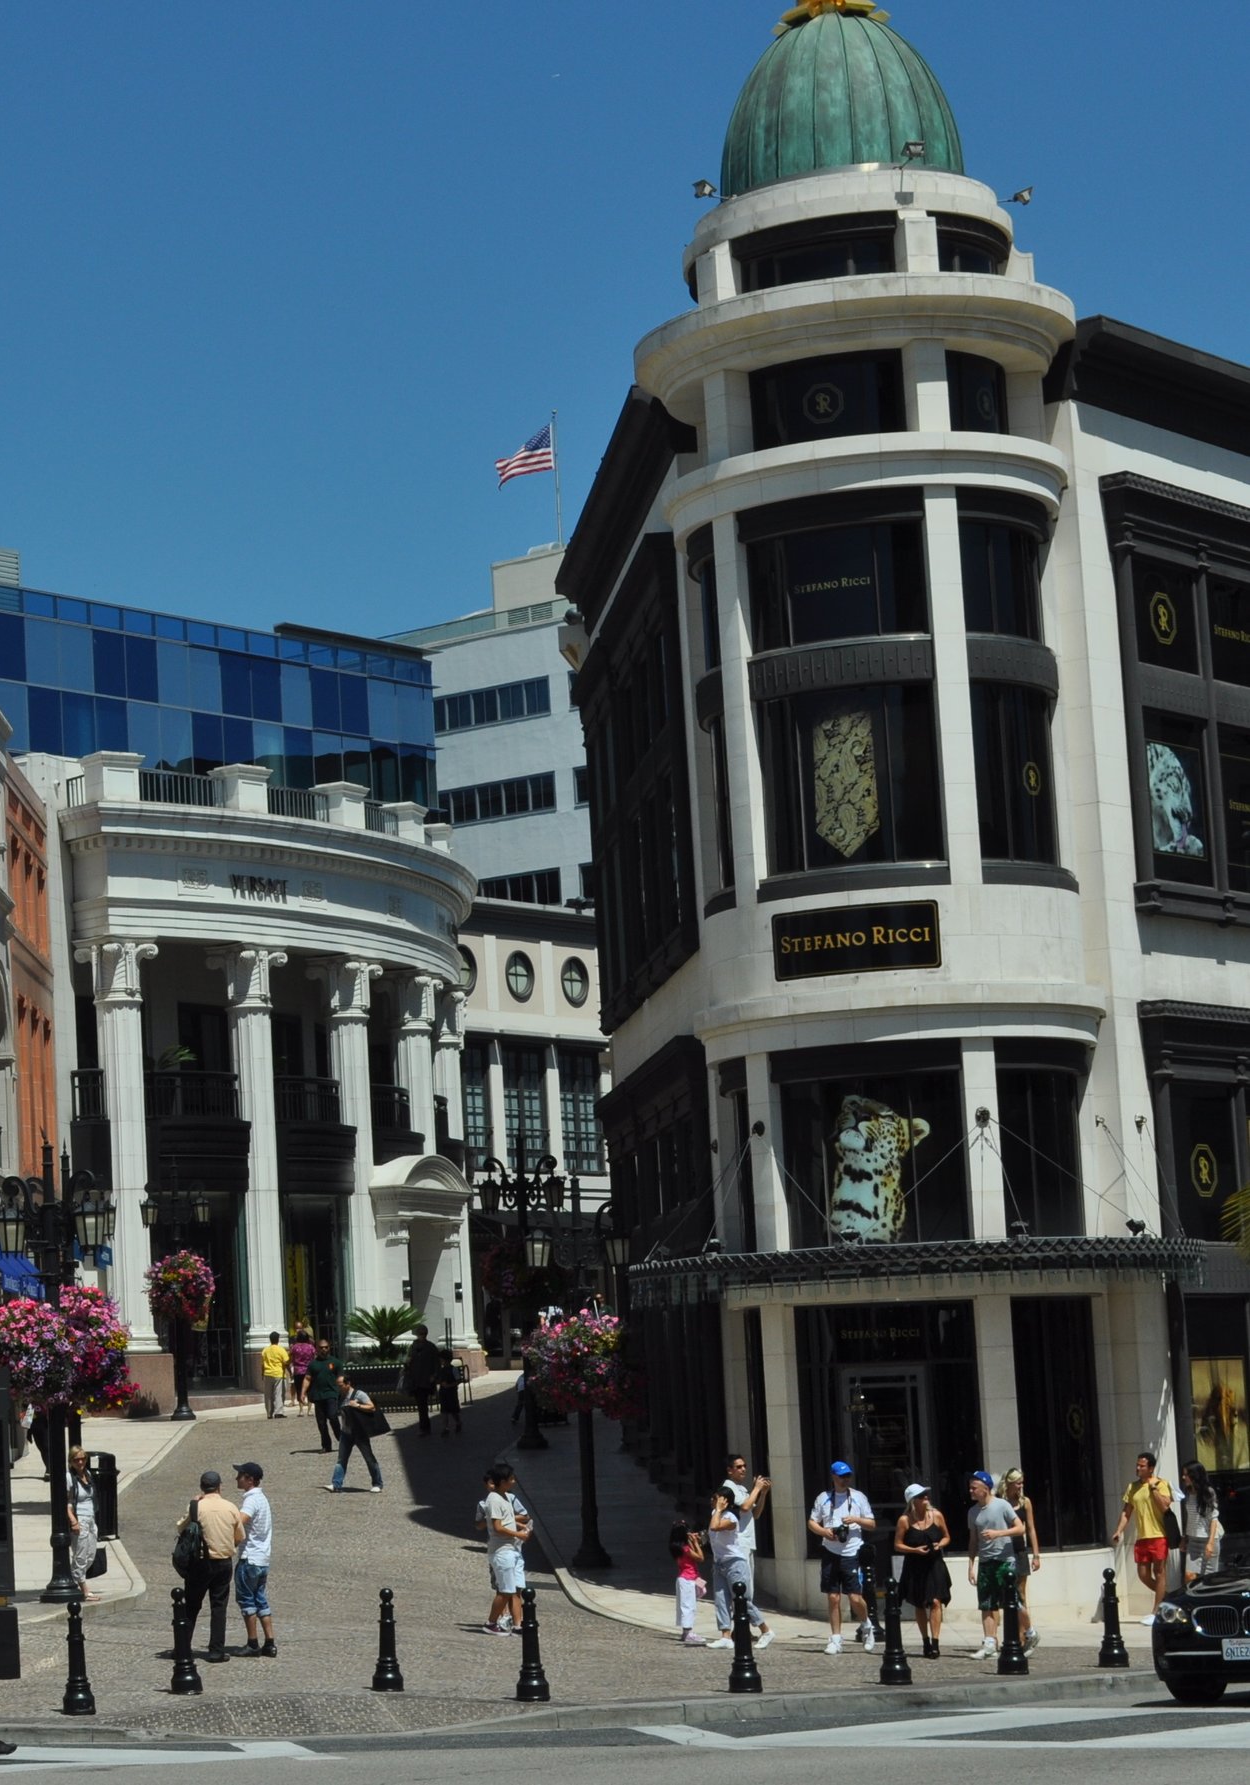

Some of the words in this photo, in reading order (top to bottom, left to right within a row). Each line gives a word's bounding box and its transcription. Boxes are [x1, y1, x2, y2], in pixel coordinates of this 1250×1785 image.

[794, 580, 839, 594] STEFANO
[841, 576, 871, 588] RICCI
[781, 931, 866, 954] STEFANO
[872, 926, 931, 946] RICCI
[890, 1327, 920, 1338] RICCI
